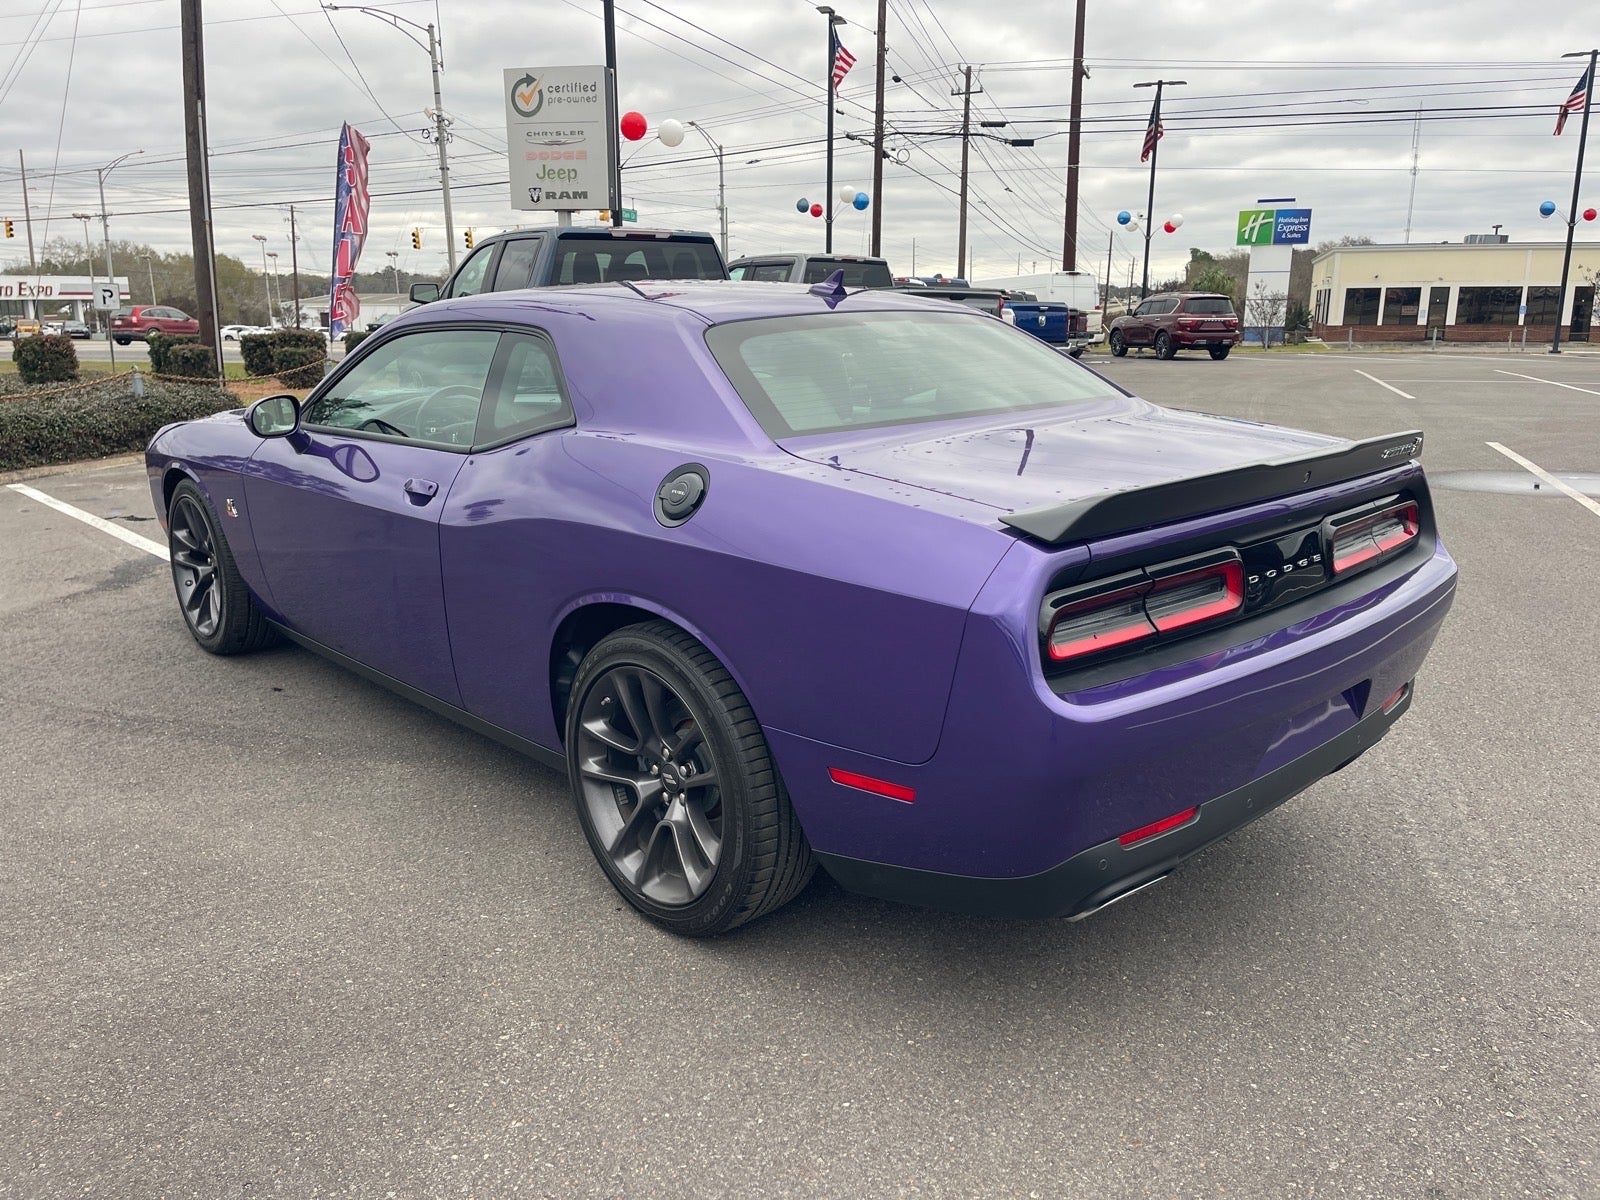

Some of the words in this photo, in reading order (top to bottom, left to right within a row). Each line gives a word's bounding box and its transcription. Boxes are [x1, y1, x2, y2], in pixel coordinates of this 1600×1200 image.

[547, 81, 597, 94] certified
[547, 94, 598, 107] pre-owned
[525, 150, 587, 161] DODGE
[535, 164, 578, 183] Jeep
[545, 190, 589, 200] RAM
[332, 145, 363, 321] SALE
[1277, 223, 1308, 233] Express
[1248, 553, 1321, 584] DODGE
